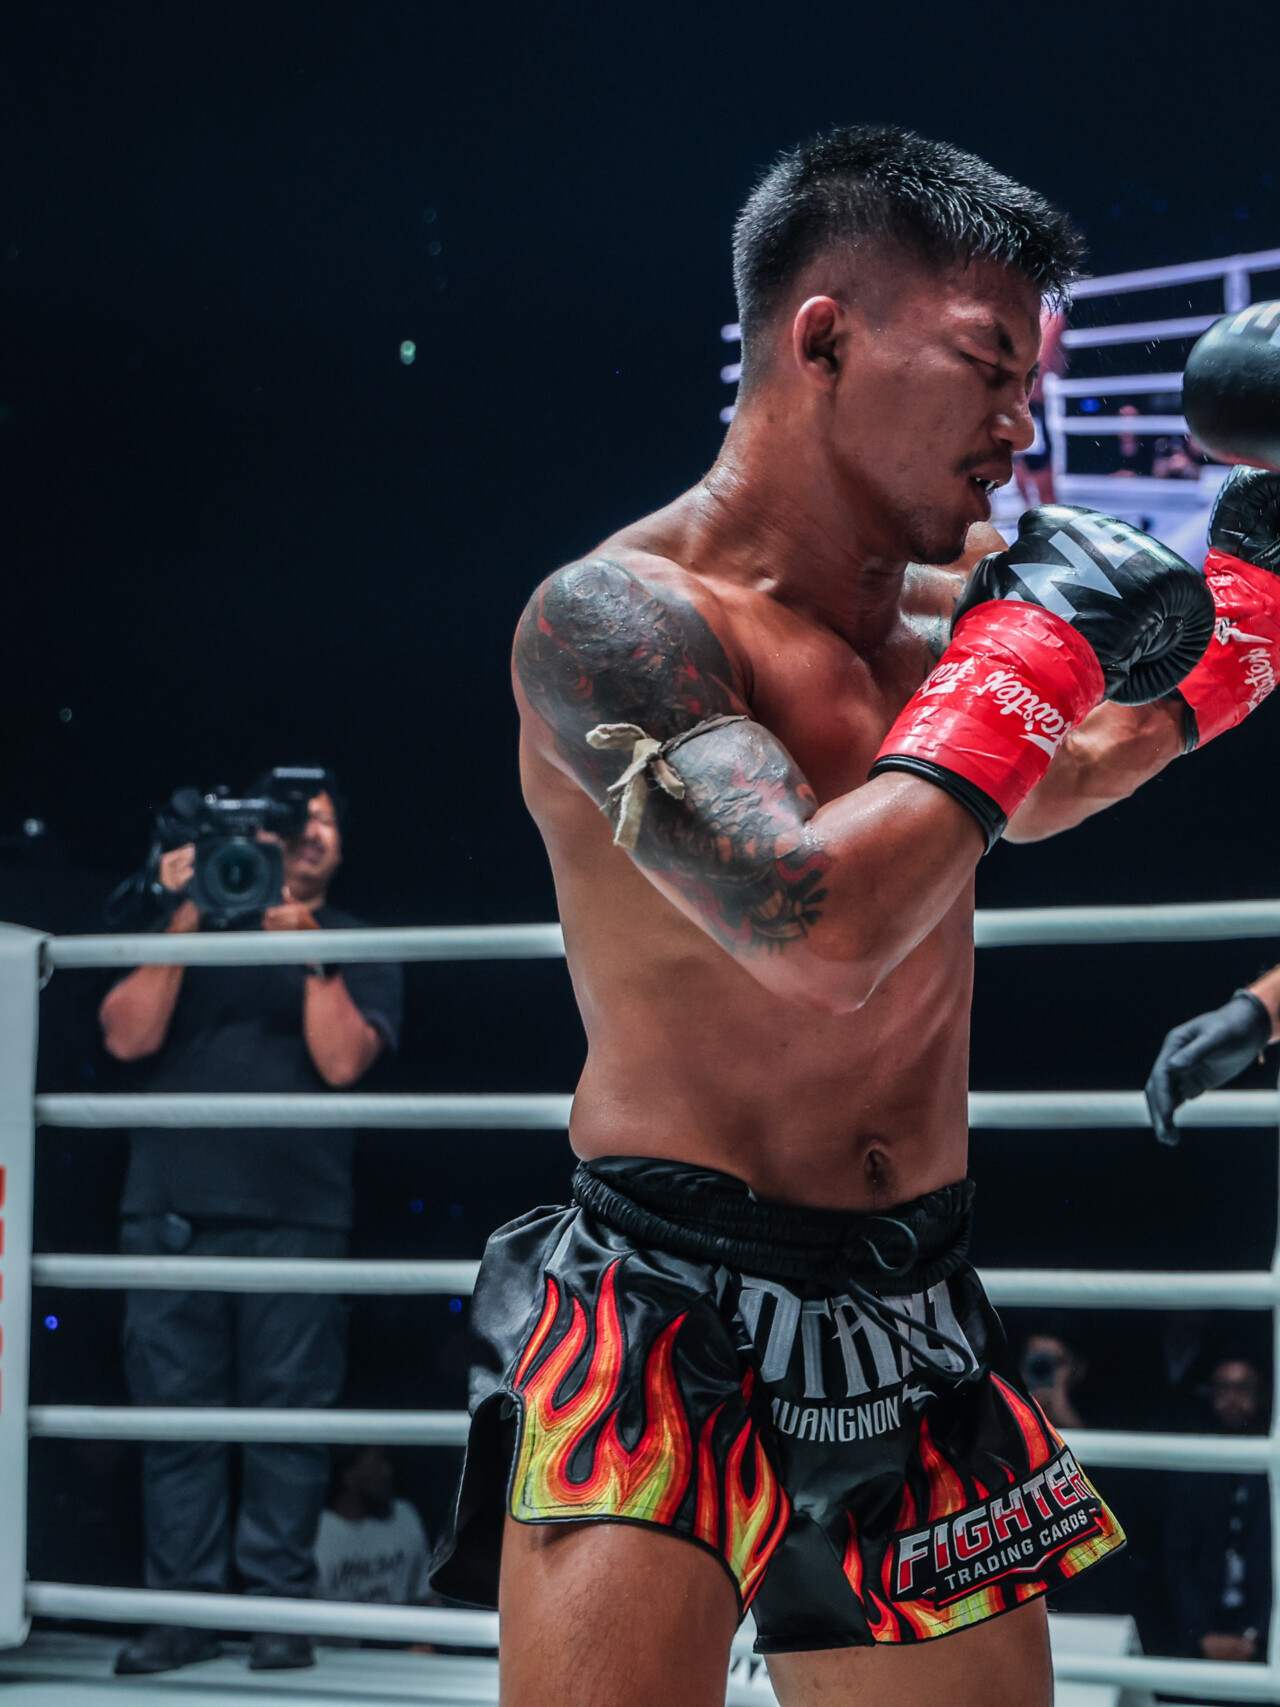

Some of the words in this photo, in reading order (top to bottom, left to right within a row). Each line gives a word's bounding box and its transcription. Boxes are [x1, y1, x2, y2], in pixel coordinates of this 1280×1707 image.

[1004, 511, 1146, 624] NE
[896, 1450, 1096, 1595] FIGHTER
[944, 1540, 1034, 1591] TRADING
[1038, 1508, 1088, 1547] CARDS
